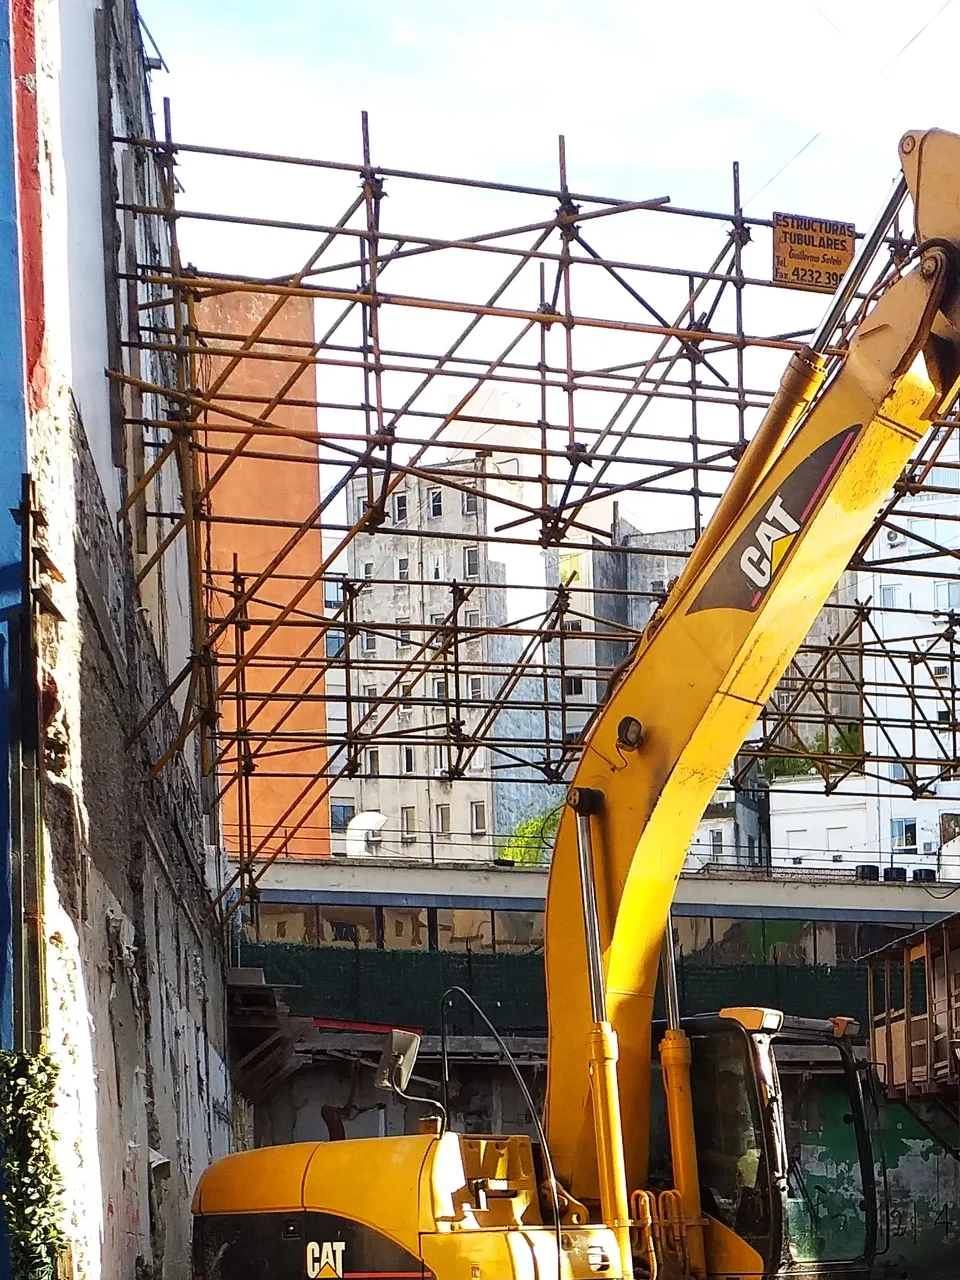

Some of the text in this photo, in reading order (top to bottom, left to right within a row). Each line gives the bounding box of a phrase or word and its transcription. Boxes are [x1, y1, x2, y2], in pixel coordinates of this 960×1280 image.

[775, 213, 854, 237] ESTRUCTURAS
[791, 266, 822, 284] 4232
[740, 494, 801, 588] CAT
[306, 1241, 346, 1279] CAT
